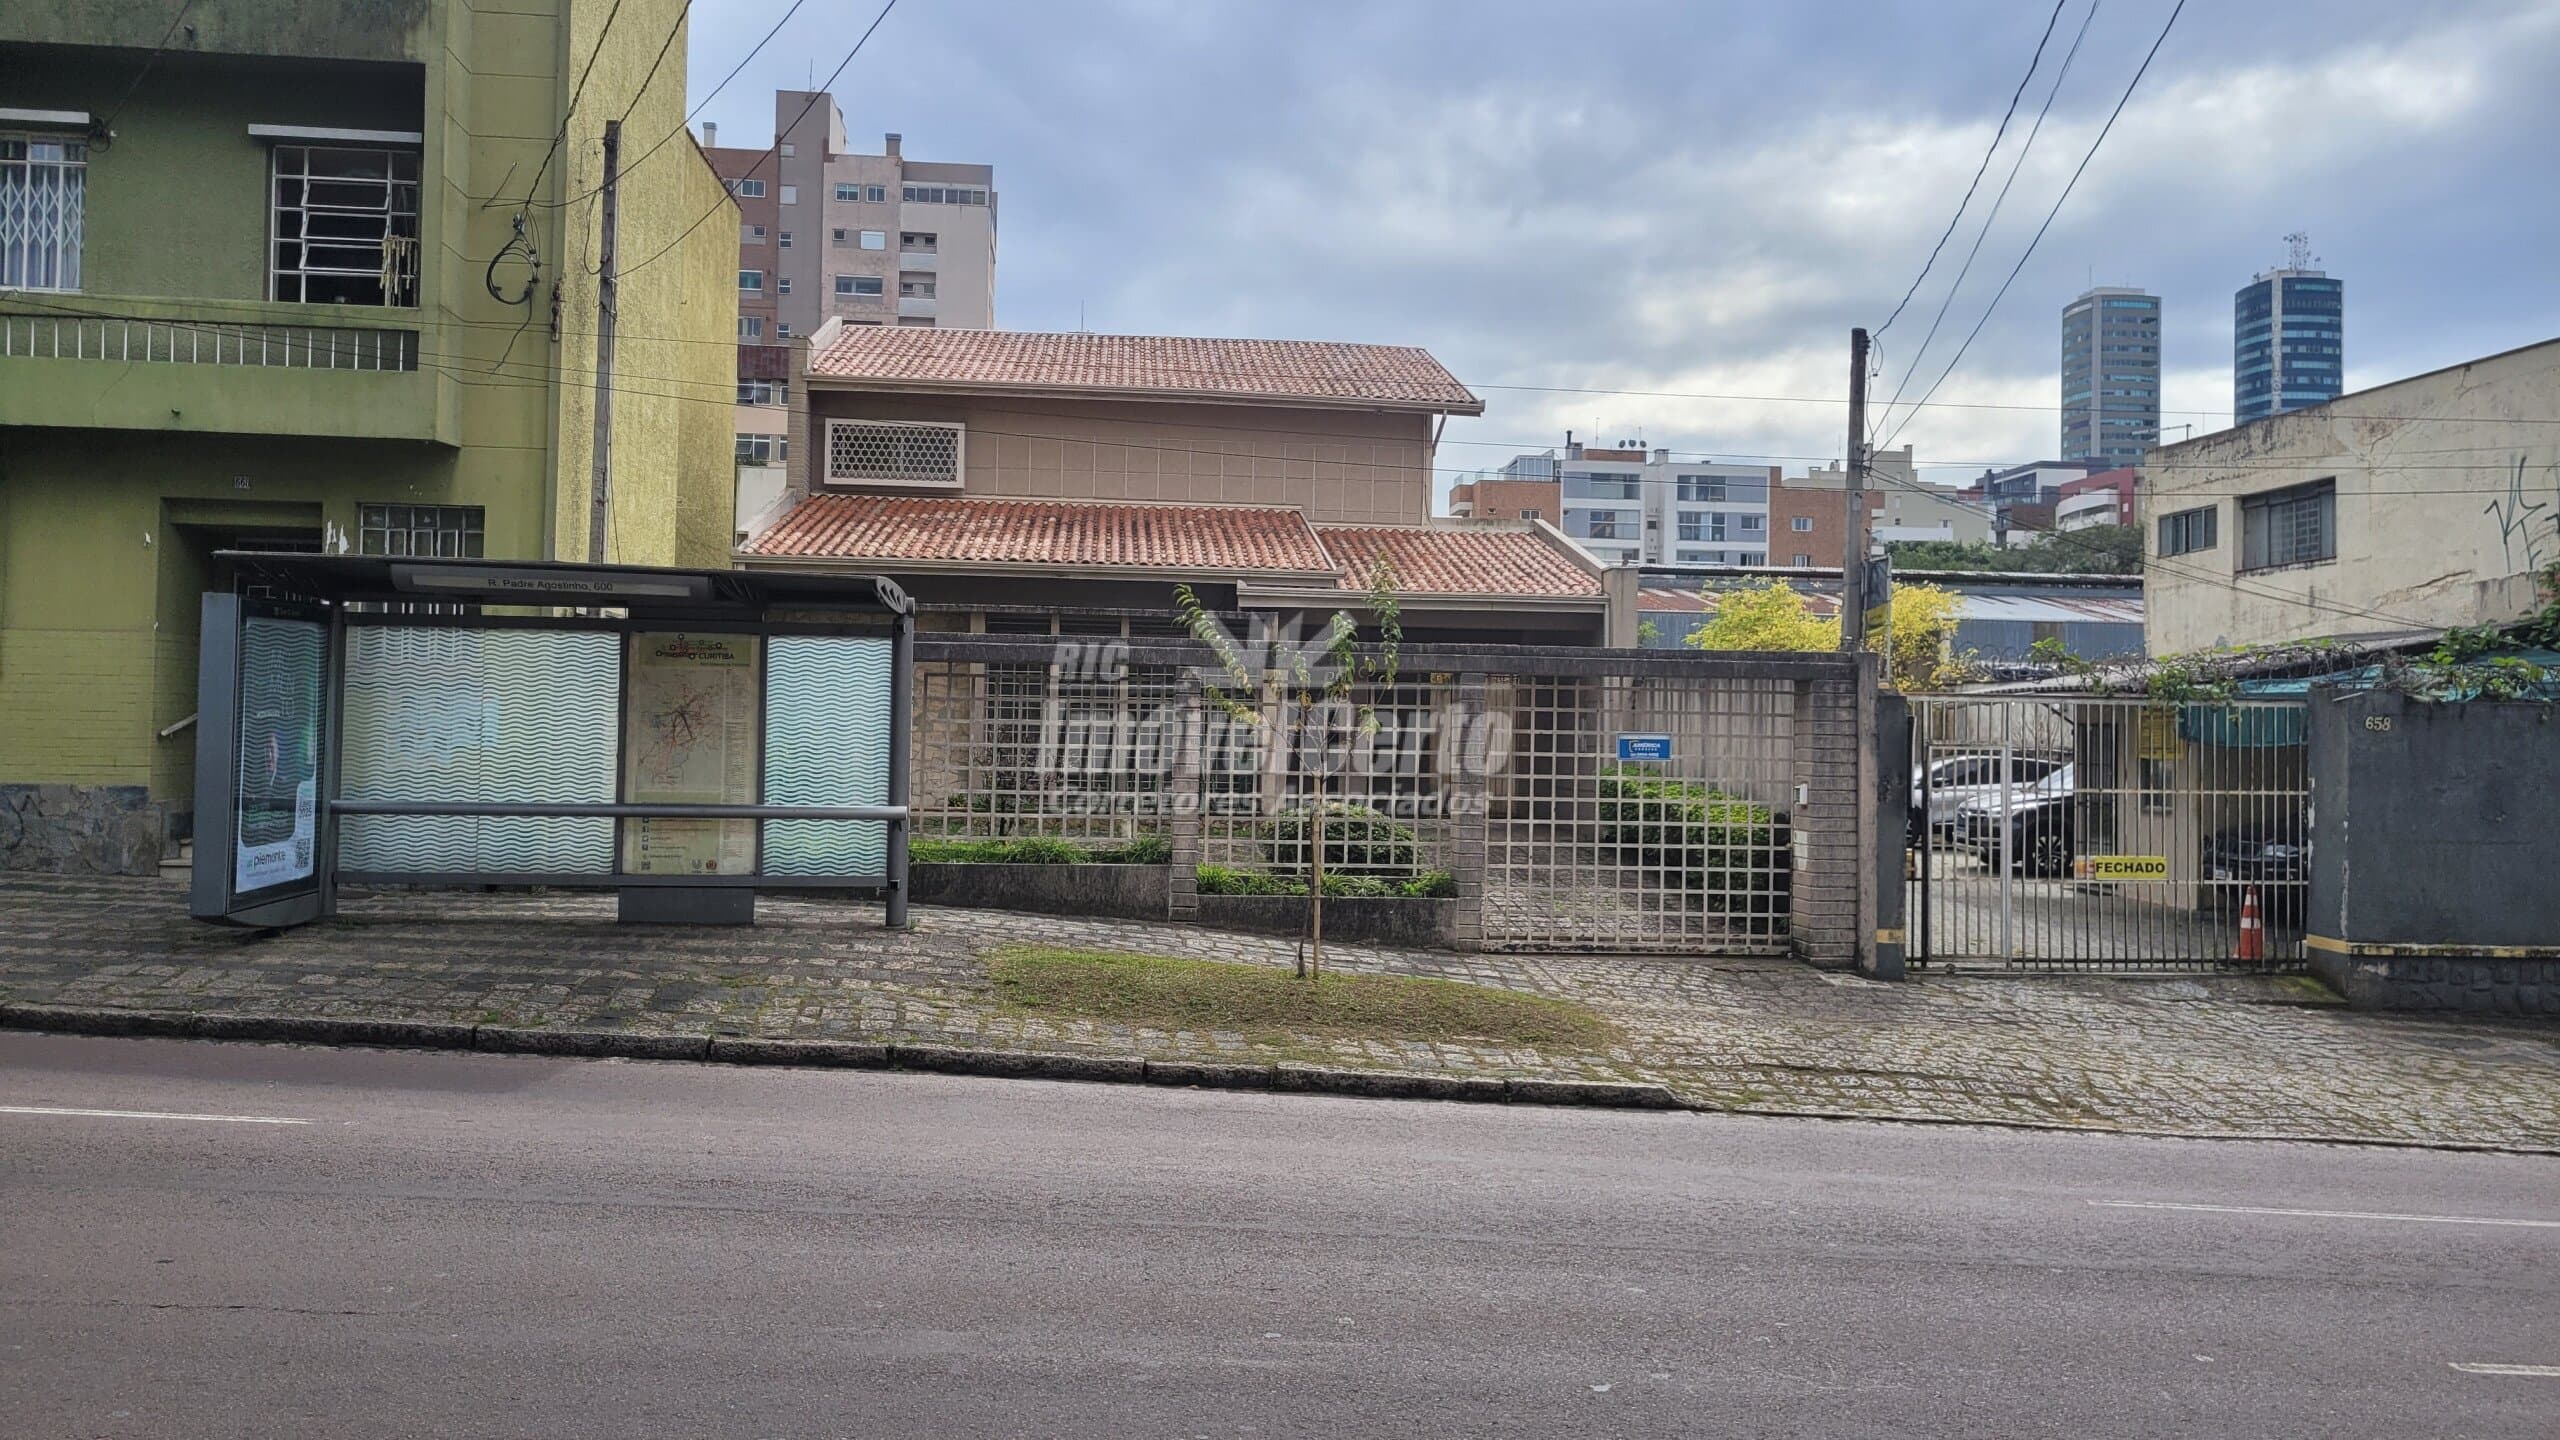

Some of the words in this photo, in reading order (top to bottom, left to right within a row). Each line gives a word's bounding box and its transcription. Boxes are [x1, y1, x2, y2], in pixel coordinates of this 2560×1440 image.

[487, 578, 499, 587] R.
[503, 578, 533, 589] Padre
[536, 580, 592, 593] Agostinho,
[594, 581, 613, 592] 600
[2365, 716, 2391, 731] 658
[2095, 862, 2166, 874] FECHADO
